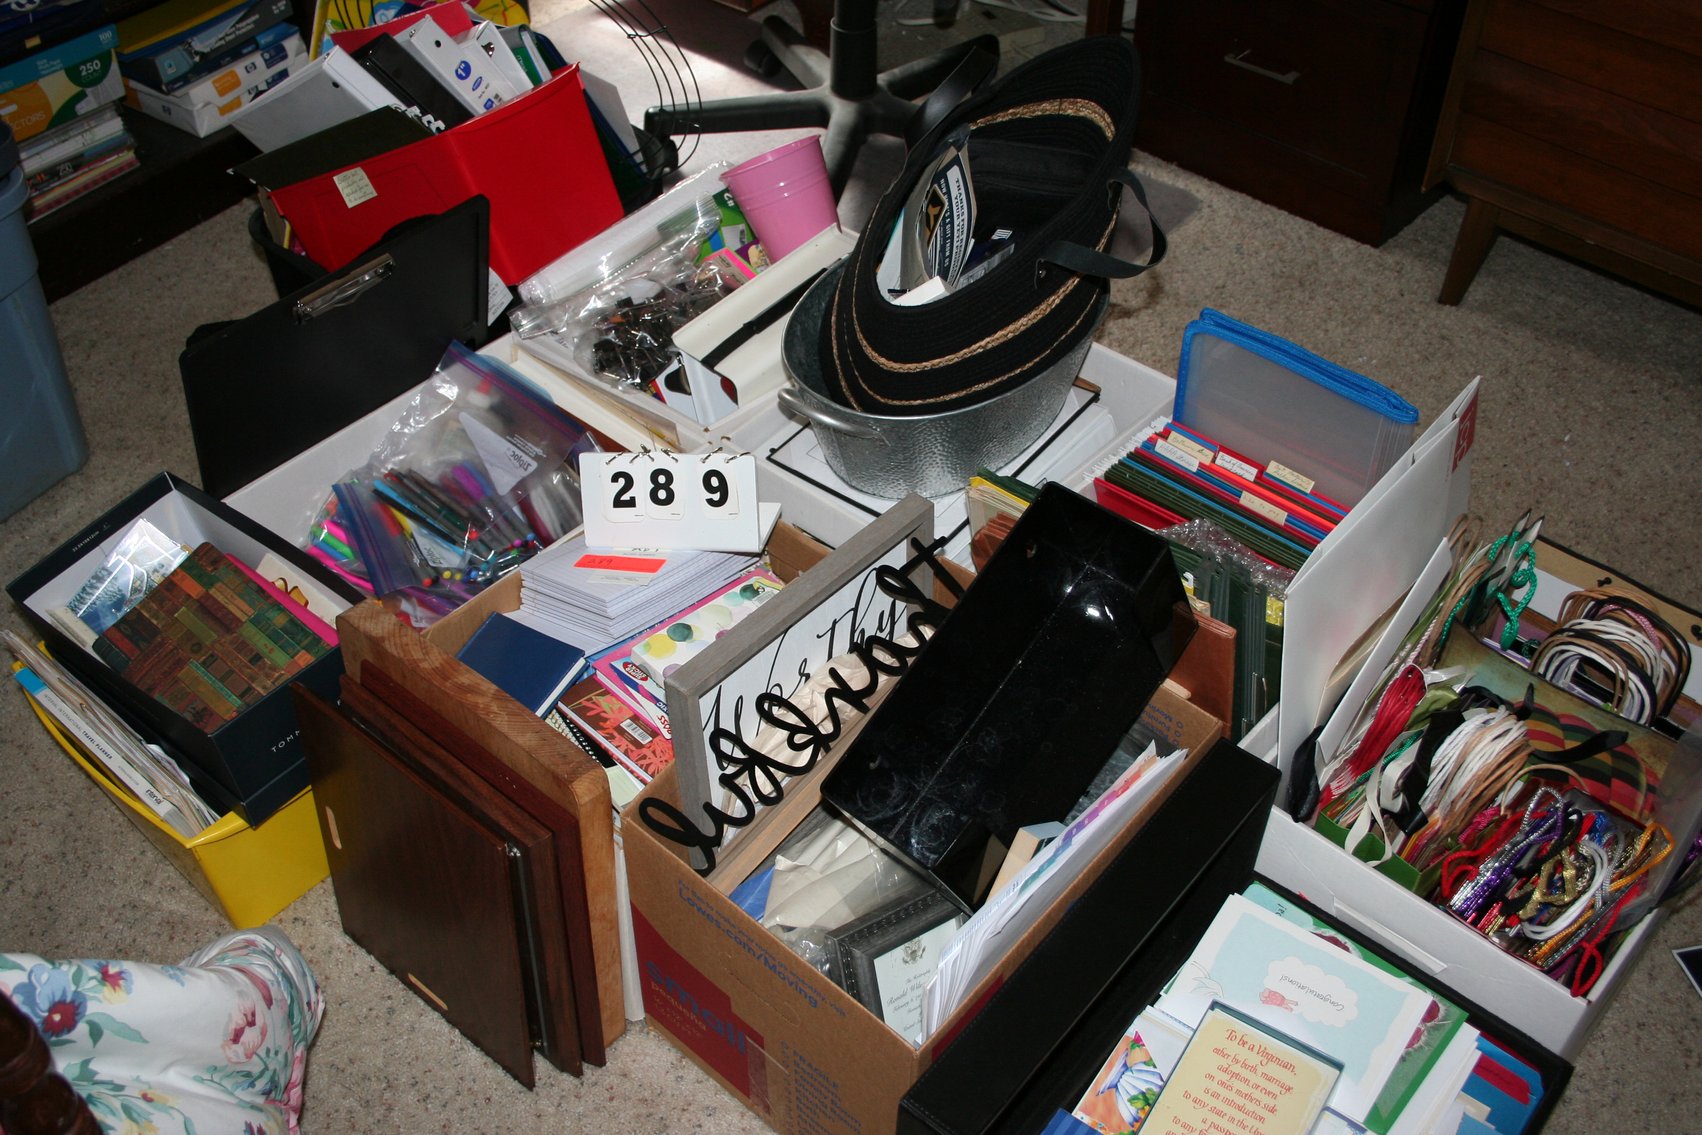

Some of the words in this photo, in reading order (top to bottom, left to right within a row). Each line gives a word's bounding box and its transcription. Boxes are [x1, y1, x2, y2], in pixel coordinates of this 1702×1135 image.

[99, 31, 112, 40] 100
[80, 60, 101, 75] 250
[955, 177, 967, 218] THANKS
[82, 730, 96, 745] TRAVEL
[1279, 975, 1345, 1012] Congratulations!
[1226, 1028, 1237, 1042] To
[1237, 1032, 1249, 1047] be
[1212, 1046, 1232, 1061] either
[1204, 1072, 1216, 1082] on
[1259, 1086, 1279, 1101] even
[1182, 1089, 1192, 1101] to
[1191, 1095, 1210, 1111] any
[1208, 1104, 1228, 1120] state
[1235, 1117, 1250, 1132] the
[1209, 1090, 1221, 1101] an
[1220, 1095, 1267, 1125] introduction
[1172, 1115, 1181, 1126] to
[1180, 1120, 1198, 1135] any
